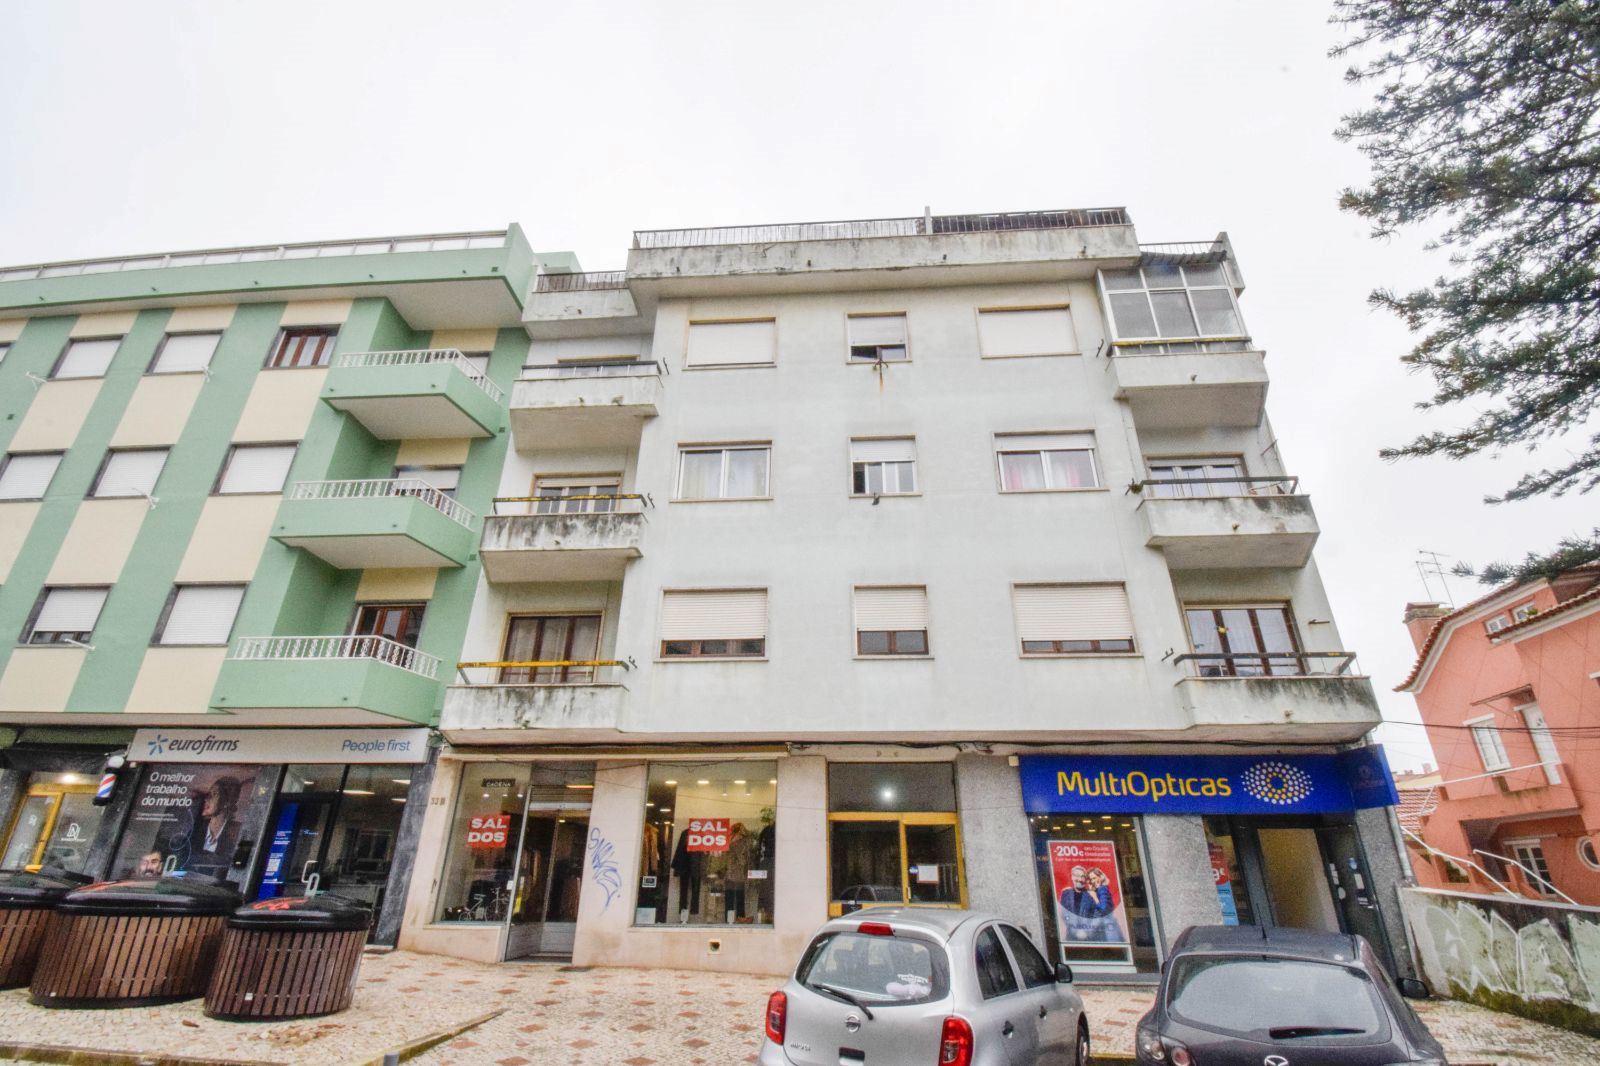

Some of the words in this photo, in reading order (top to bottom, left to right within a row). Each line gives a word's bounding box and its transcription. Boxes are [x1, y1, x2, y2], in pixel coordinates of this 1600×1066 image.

[168, 735, 240, 755] eurofirms
[342, 740, 385, 753] People
[387, 739, 411, 751] first
[150, 771, 159, 782] O
[160, 771, 196, 783] melhor
[146, 784, 188, 795] trabalho
[1057, 771, 1232, 802] MultiOpticas
[141, 796, 155, 806] do
[156, 796, 193, 807] mundo
[471, 818, 507, 829] SAL
[690, 821, 728, 832] SAL
[467, 832, 505, 843] DOS
[688, 834, 727, 846] DOS
